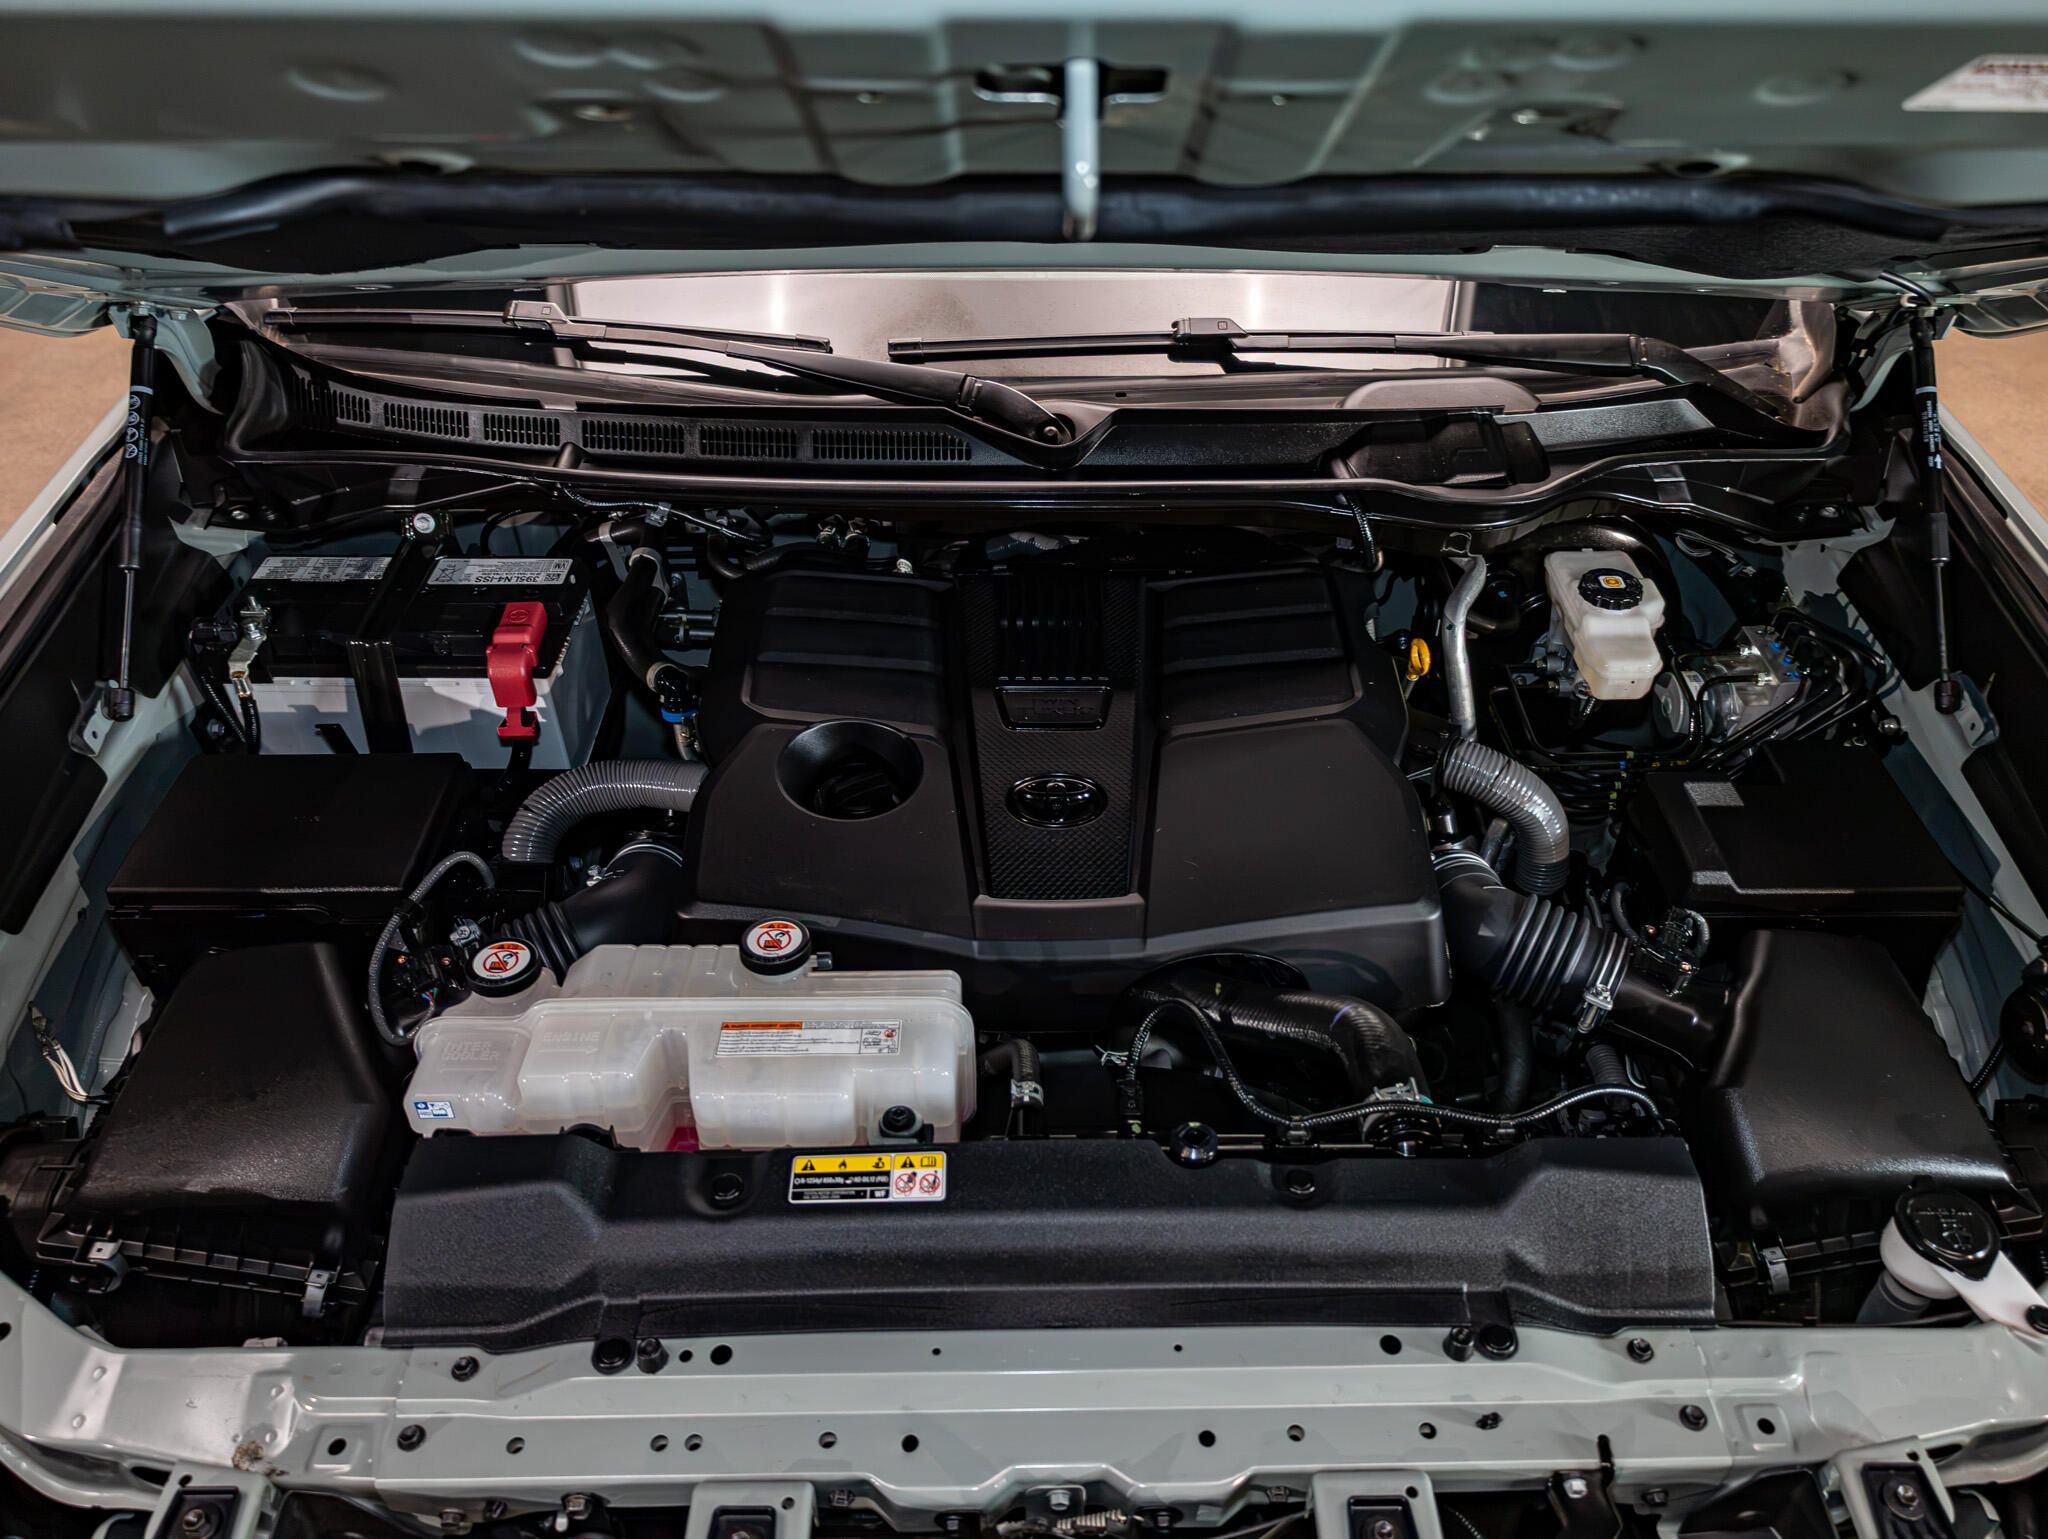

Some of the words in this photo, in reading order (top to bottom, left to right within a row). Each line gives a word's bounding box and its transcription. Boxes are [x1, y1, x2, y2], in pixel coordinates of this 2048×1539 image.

[475, 575, 540, 583] 395LN4-ISS
[544, 1031, 600, 1041] ENGINE
[447, 1040, 491, 1050] INTER
